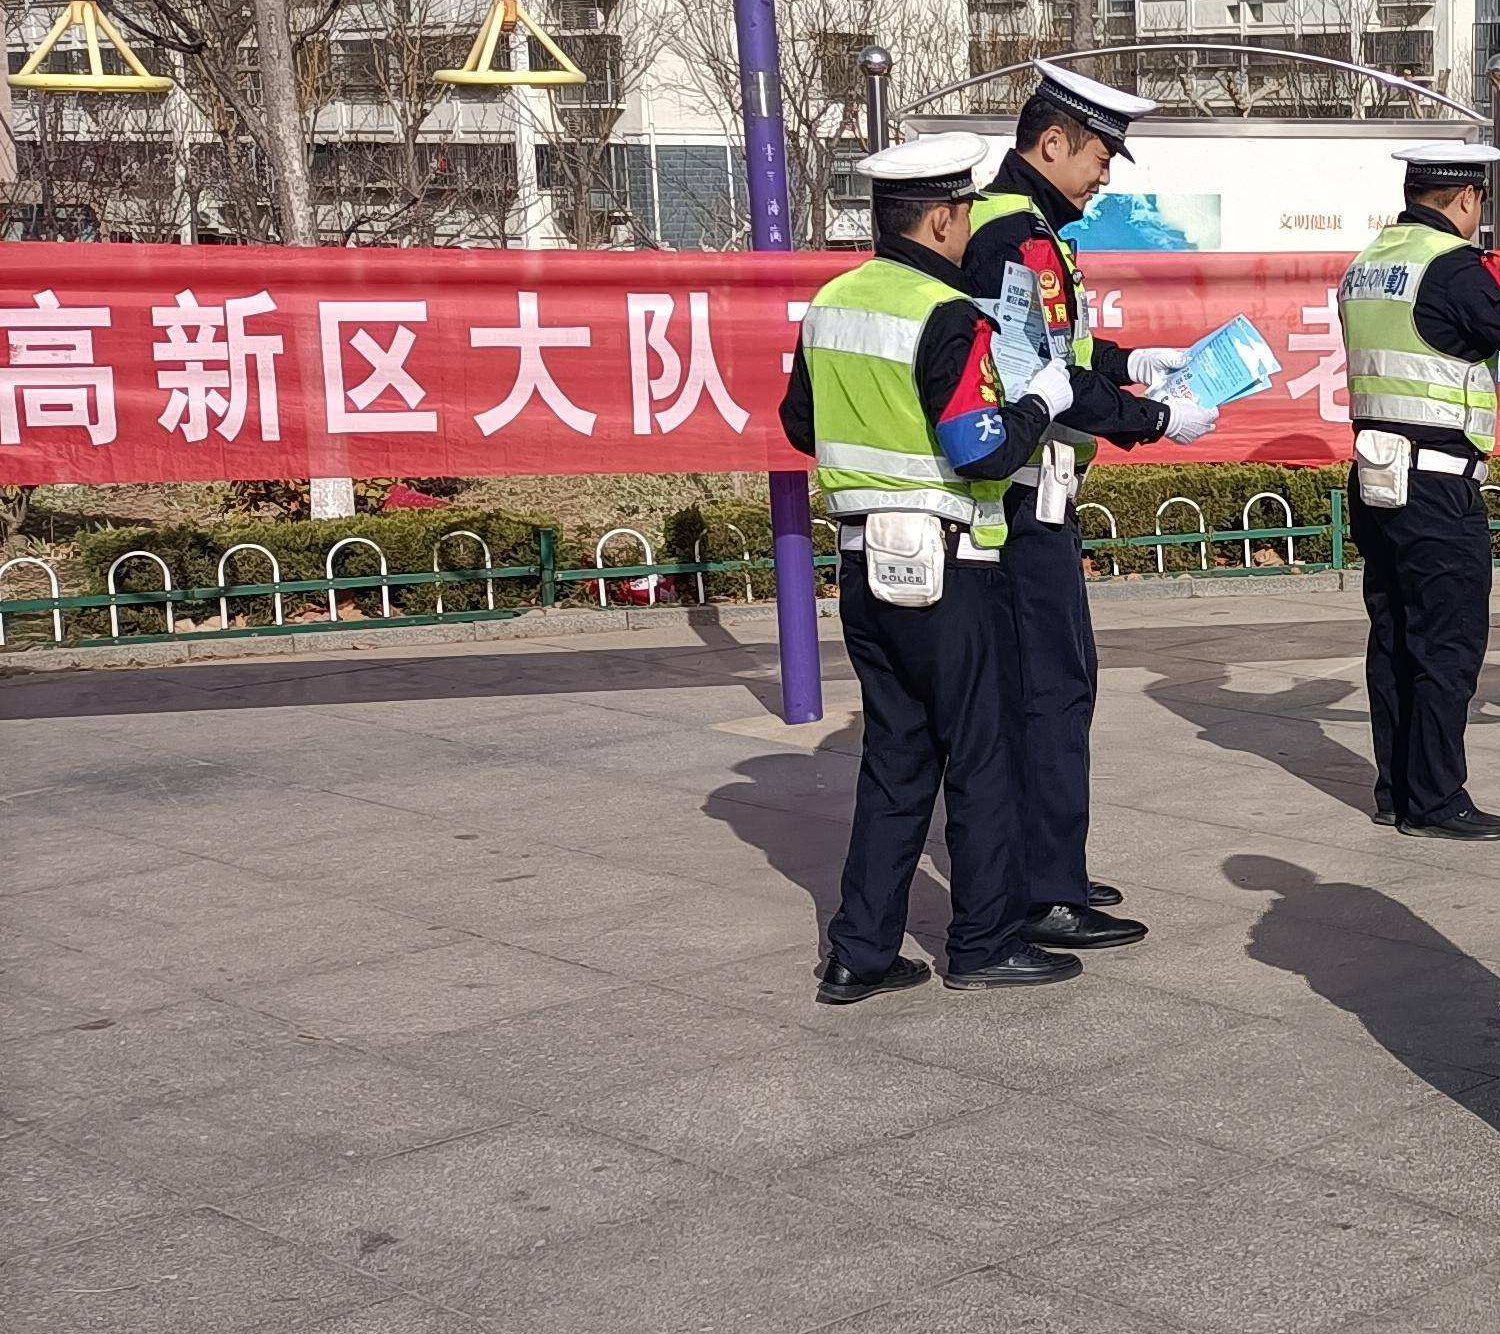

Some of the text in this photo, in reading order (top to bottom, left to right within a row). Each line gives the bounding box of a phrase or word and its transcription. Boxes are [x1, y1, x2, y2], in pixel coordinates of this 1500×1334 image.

[1383, 265, 1409, 296] 勤
[0, 289, 751, 447] 高新区大队
[881, 574, 924, 584] POLICE
